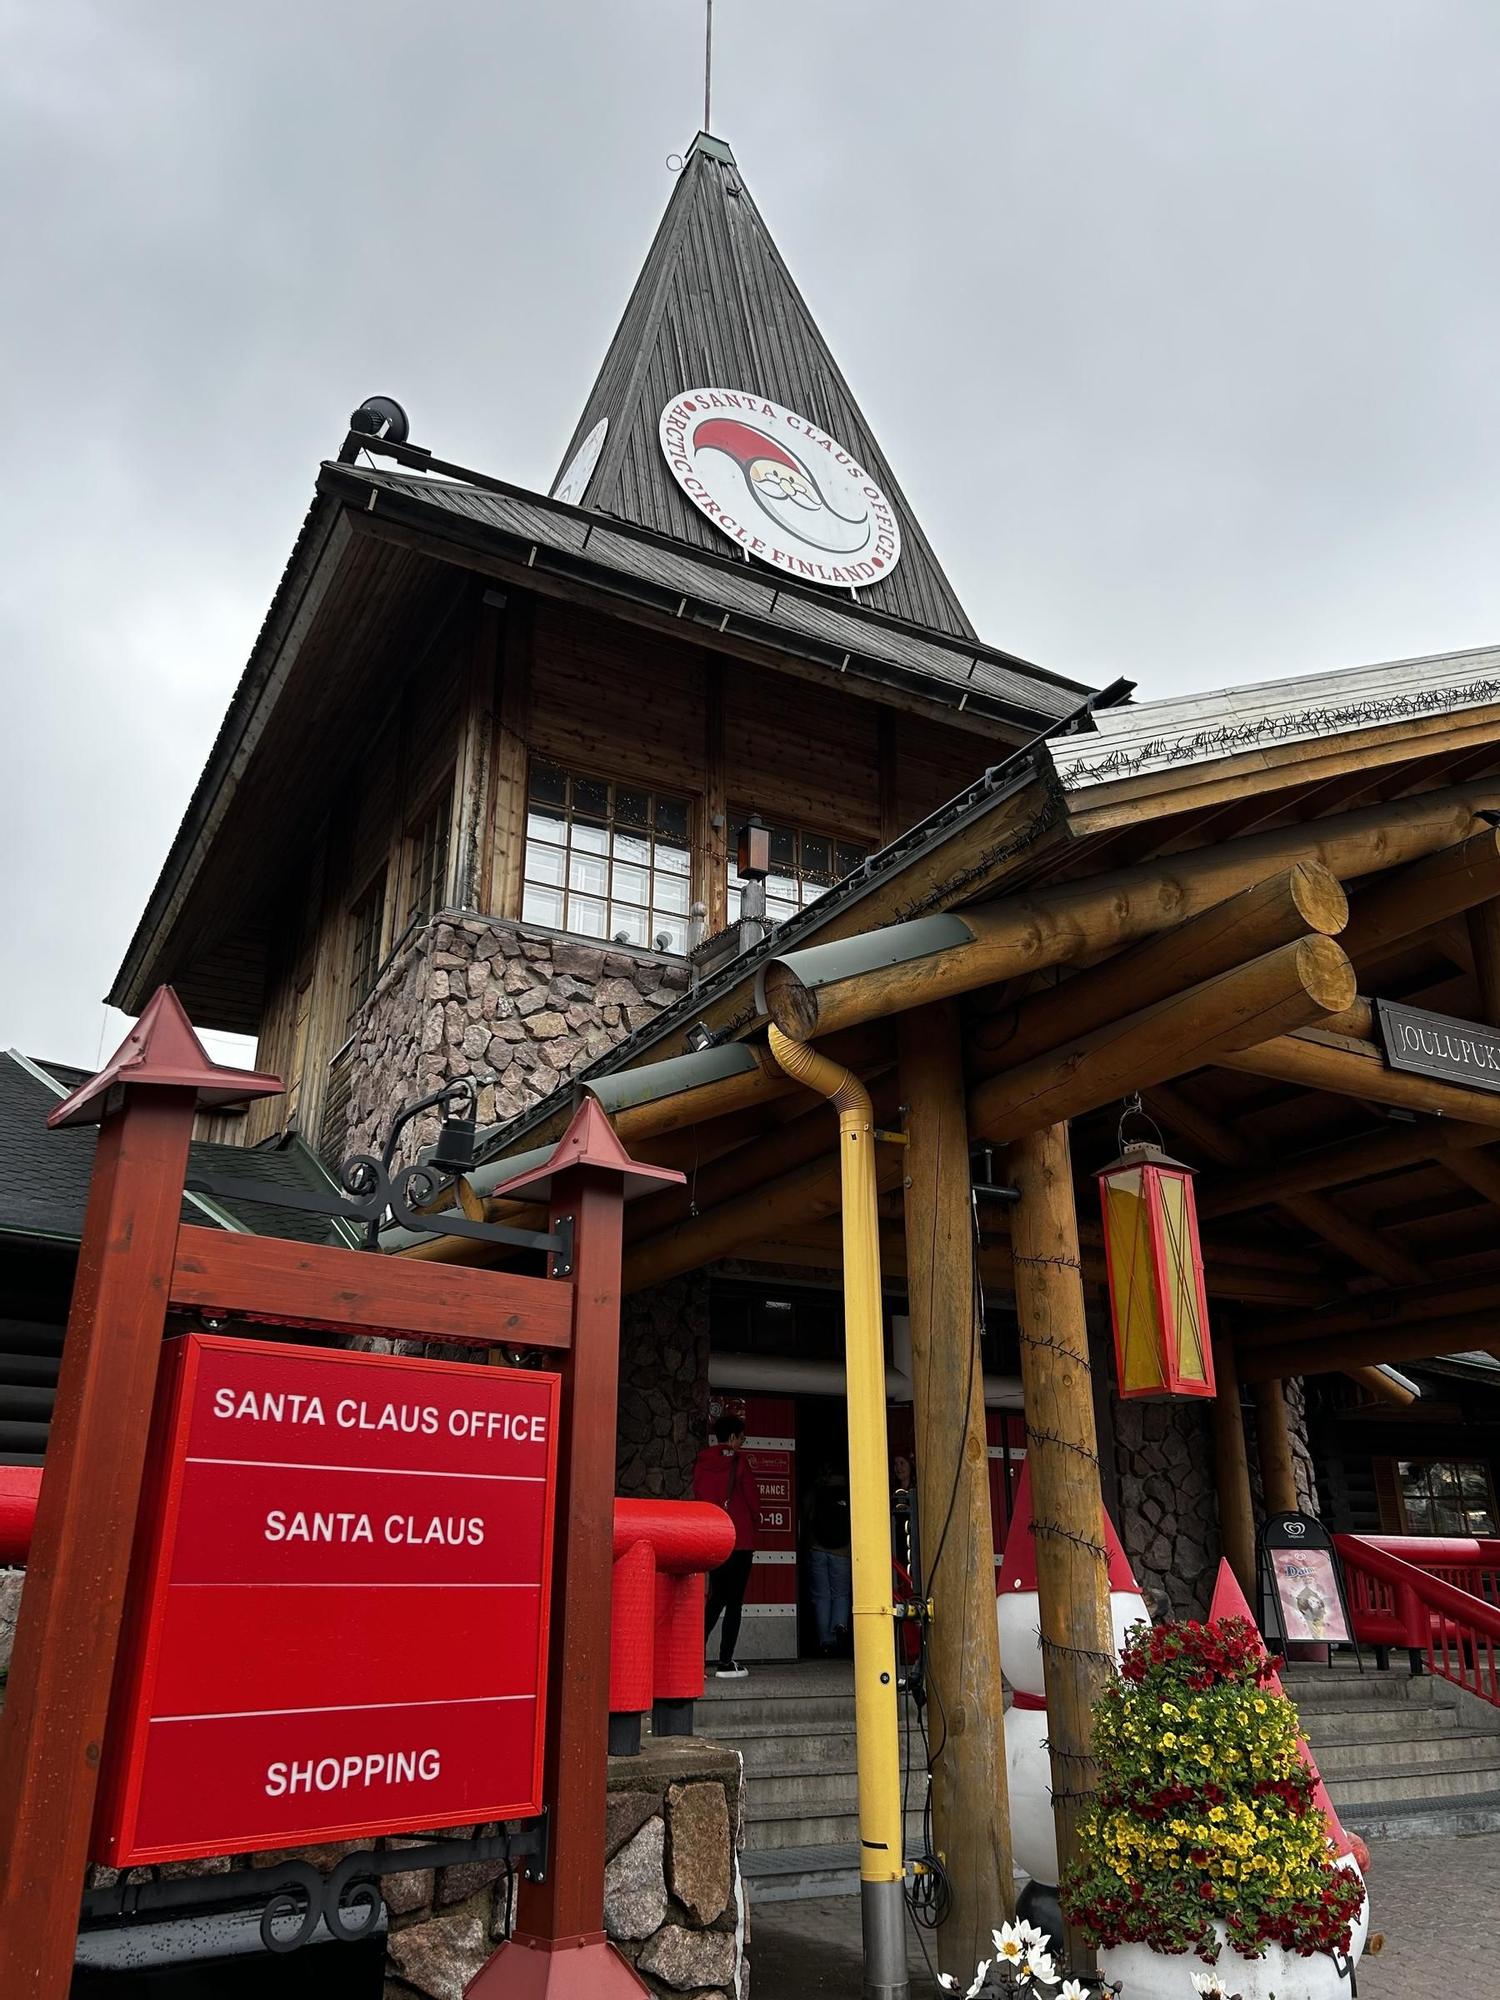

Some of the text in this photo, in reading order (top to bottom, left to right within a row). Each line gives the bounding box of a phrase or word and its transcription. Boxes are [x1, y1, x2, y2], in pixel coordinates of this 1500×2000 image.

[666, 404, 693, 473] ARCTIC
[684, 477, 767, 554] CIRCLE
[771, 547, 875, 582] FINLAND
[694, 393, 896, 560] SANTA CLAUS OFFICE
[1398, 1024, 1500, 1070] JOULUPUK
[213, 1387, 546, 1442] SANTA CLAUS OFFICE
[757, 1484, 785, 1495] RANCE
[264, 1510, 485, 1546] SANTA CLAUS
[265, 1748, 441, 1797] SHOPPING
